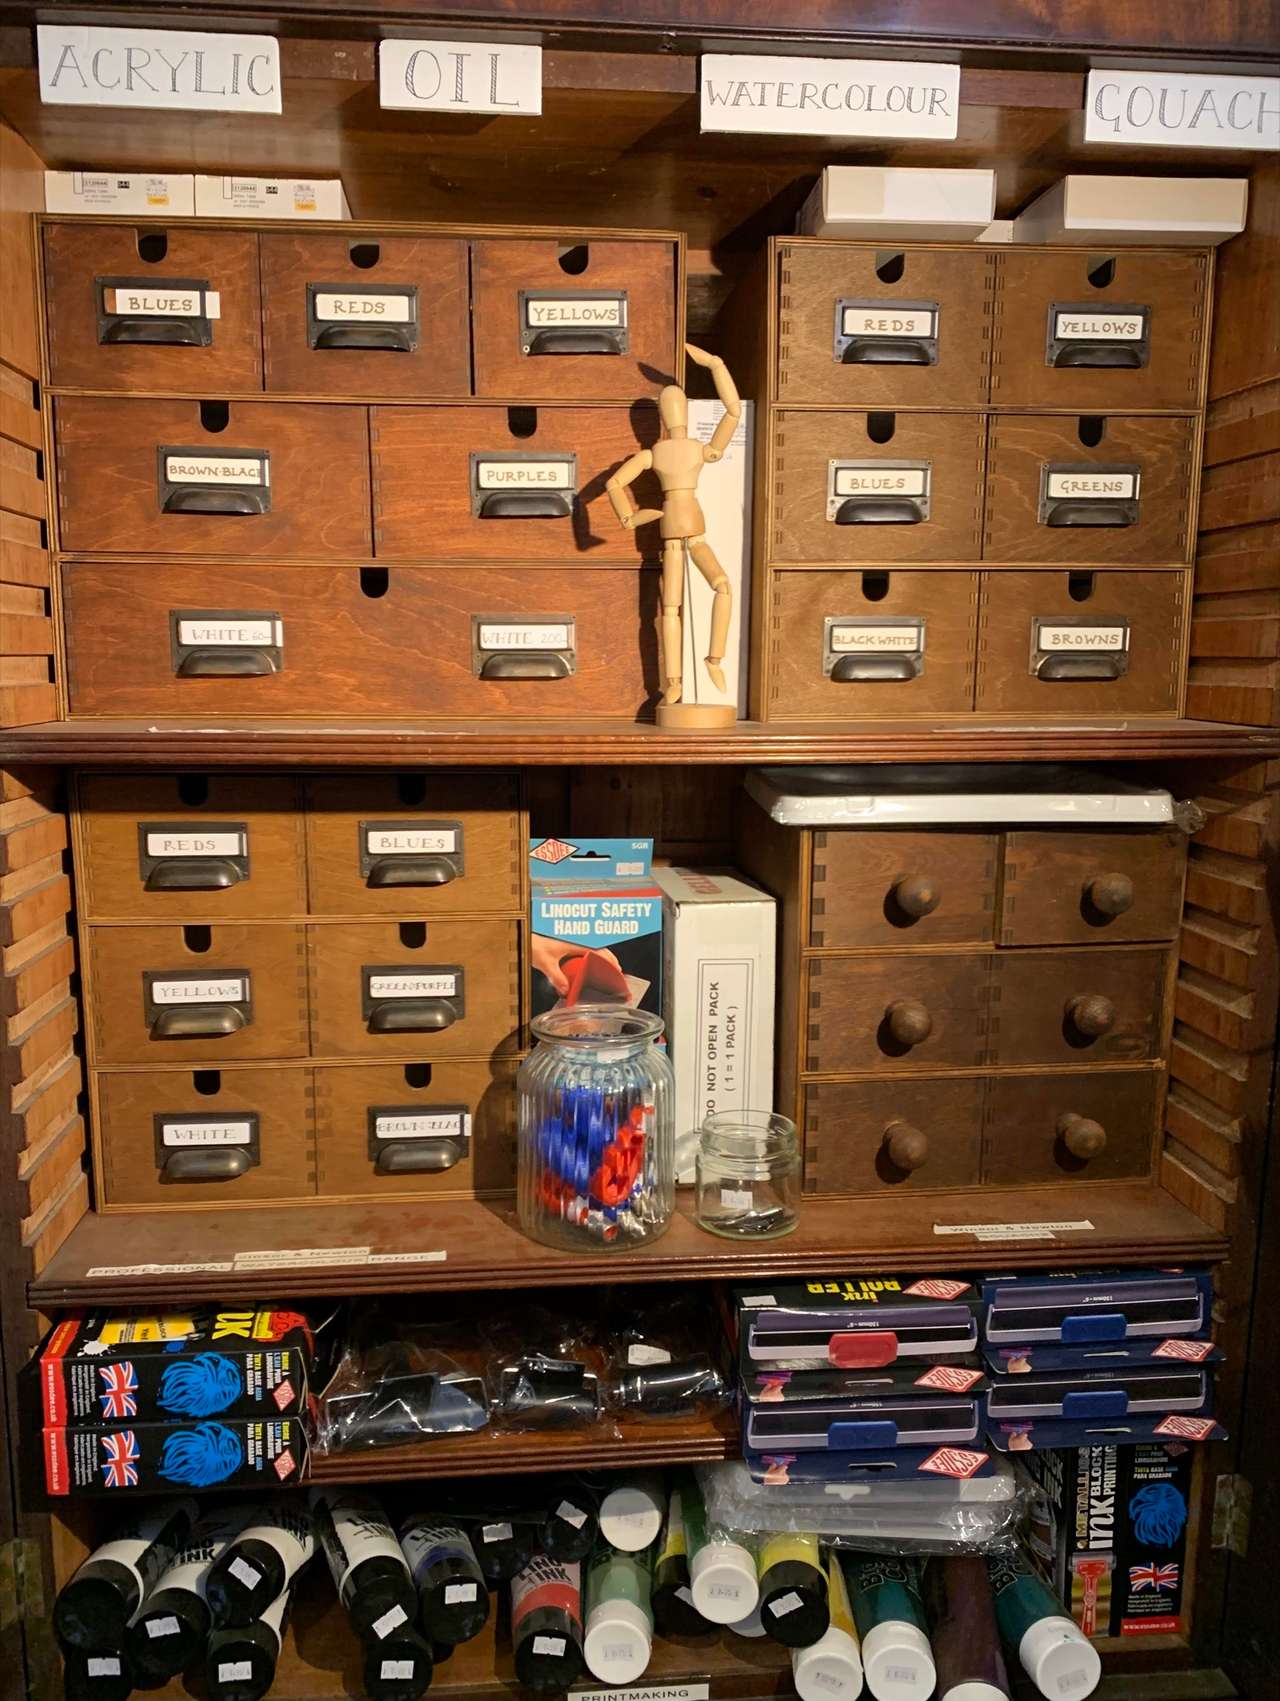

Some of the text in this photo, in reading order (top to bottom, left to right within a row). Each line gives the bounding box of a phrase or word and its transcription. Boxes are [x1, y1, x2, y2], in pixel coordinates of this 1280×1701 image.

[48, 44, 275, 96] ACRYLIC
[405, 49, 520, 107] OIL
[705, 79, 952, 118] WATERCOLOUR
[129, 296, 193, 312] BLUES
[334, 300, 386, 314] REDS
[533, 307, 619, 321] YELLOWS
[864, 319, 915, 332] REDS
[1062, 321, 1138, 334] YELLOWS
[486, 470, 557, 482] PURPLES
[850, 478, 906, 489] BLUES
[1060, 480, 1123, 493] GREENS
[192, 629, 249, 641] WHITE
[482, 631, 535, 645] WHITE
[1052, 633, 1120, 646] BROWNS
[163, 840, 216, 852] REDS
[380, 837, 445, 849] BLUES
[541, 902, 652, 918] LINOCUT SAFETY
[554, 919, 639, 935] HAND GUARD
[160, 985, 239, 998] YELLOWS
[709, 981, 720, 1017] PACK
[726, 1014, 736, 1049] PACK
[707, 1025, 718, 1060] OPEN
[706, 1065, 717, 1092] NOT
[173, 1129, 237, 1141] WHITE
[1090, 1446, 1103, 1496] BLOCK
[1103, 1444, 1117, 1496] PRINTING
[581, 1689, 689, 1701] PRINTMAKING
